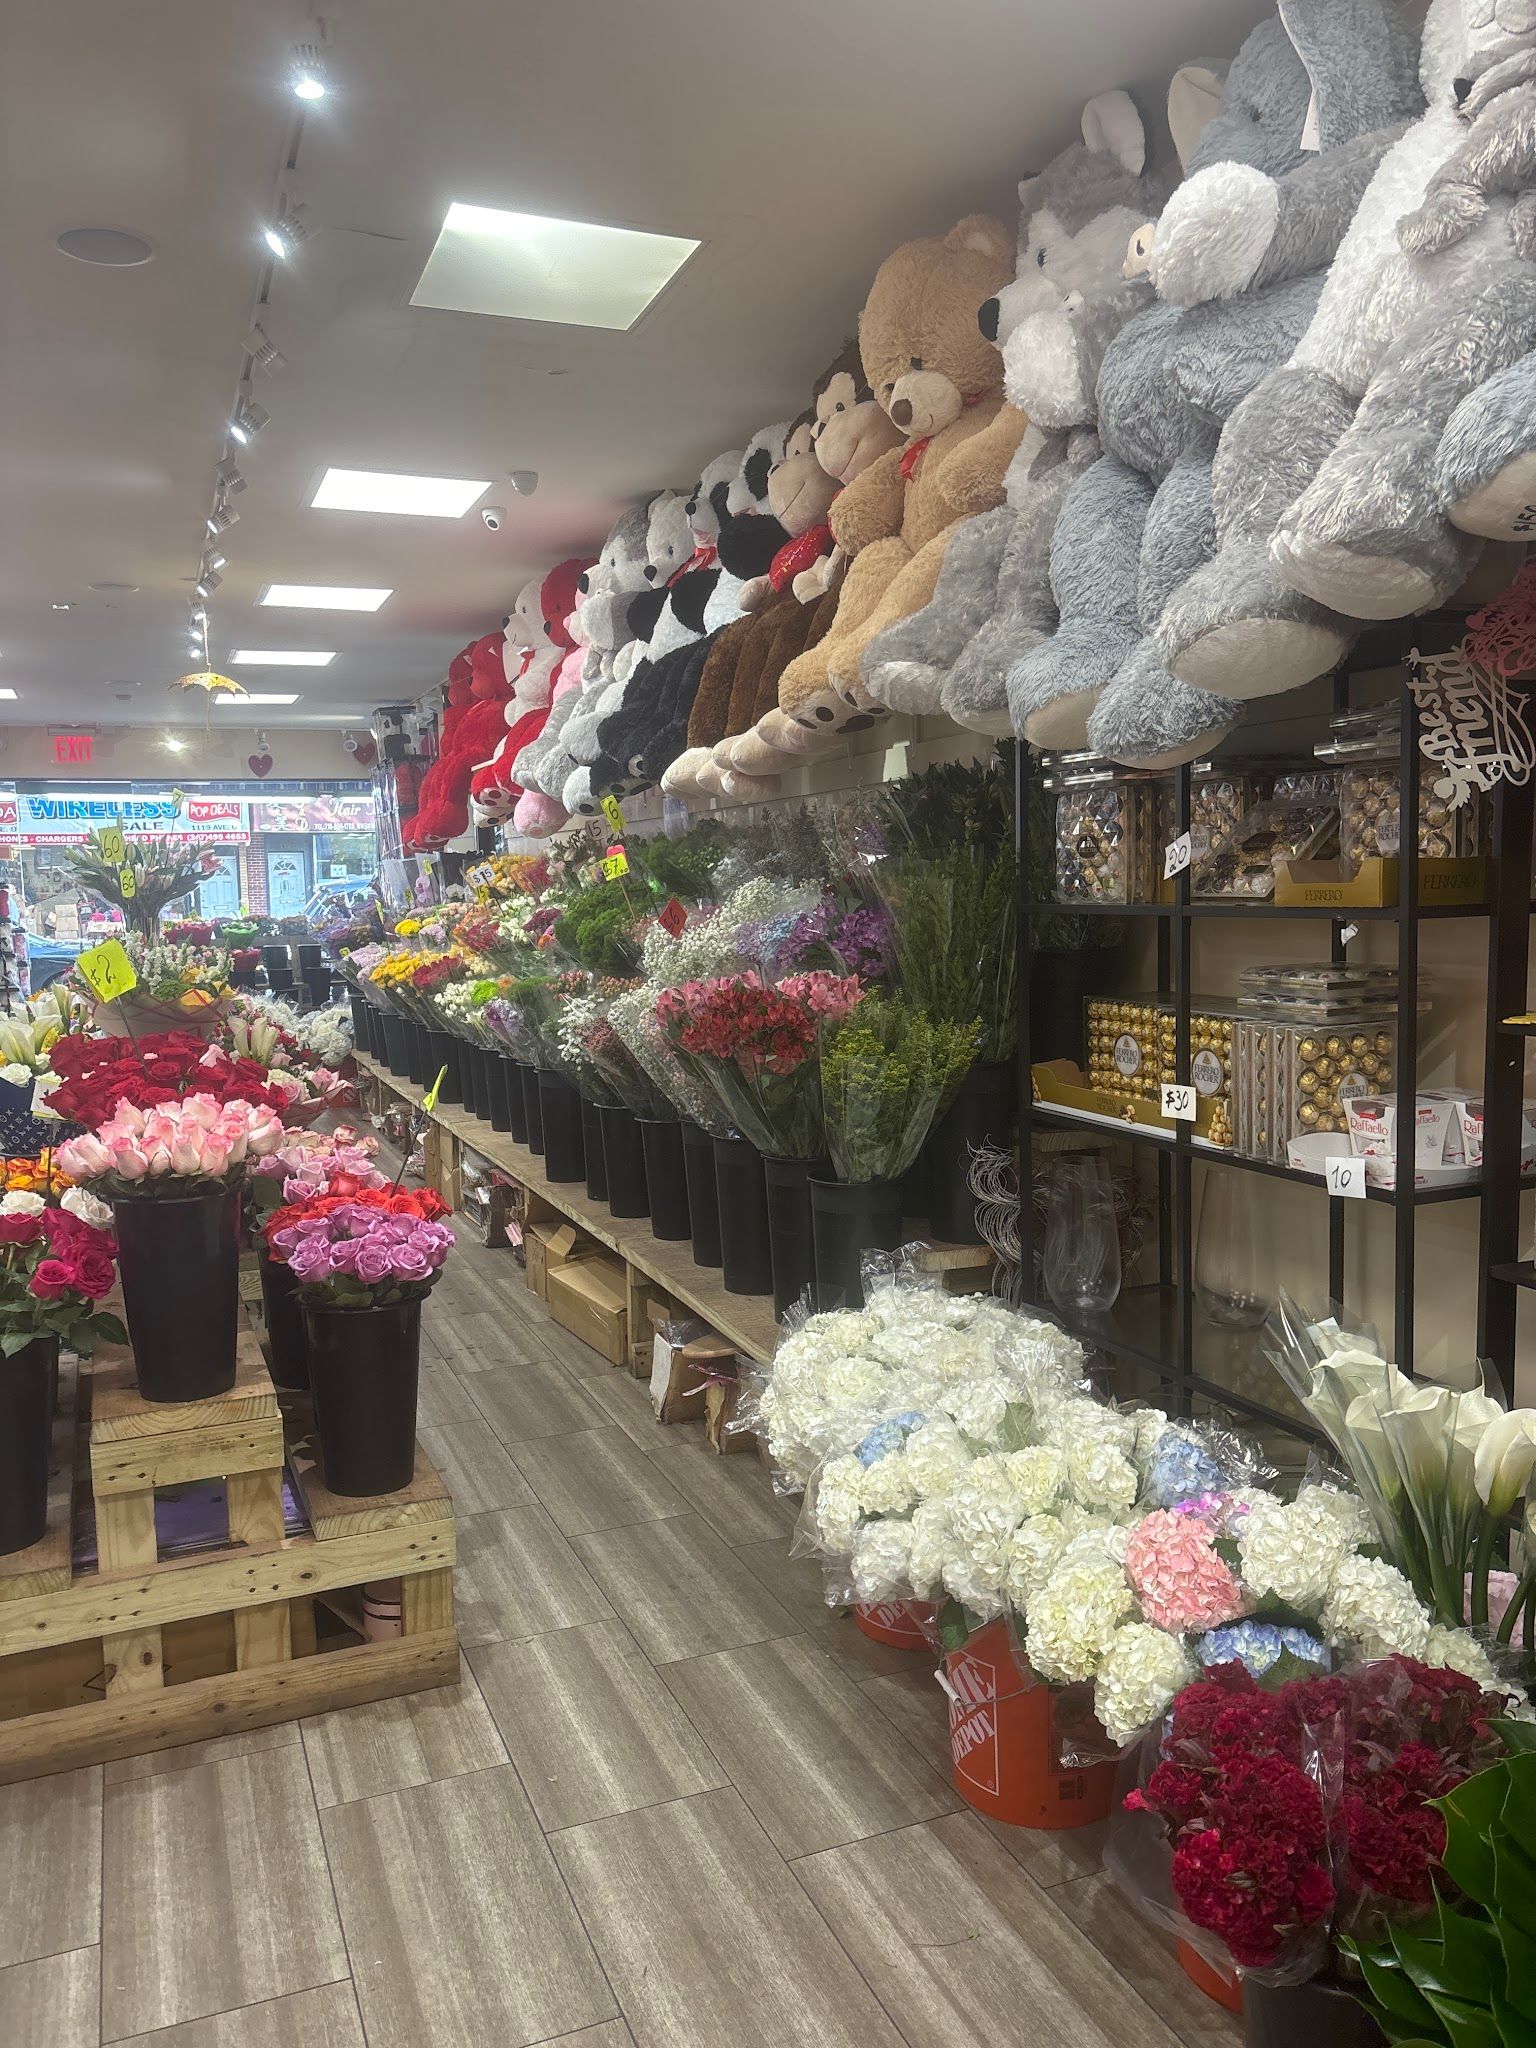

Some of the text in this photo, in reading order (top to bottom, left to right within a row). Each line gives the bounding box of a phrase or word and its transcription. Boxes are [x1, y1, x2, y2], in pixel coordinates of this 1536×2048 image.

[1406, 665, 1460, 760] Best
[55, 736, 94, 763] EXIT
[26, 797, 181, 819] WIRELESS
[190, 803, 239, 817] POP DEALS
[608, 800, 619, 820] 6
[35, 835, 84, 843] CHARGERS
[104, 834, 120, 858] 60
[1169, 845, 1188, 873] 20
[122, 875, 134, 891] 60
[1305, 889, 1342, 901] FERRERO
[1116, 1047, 1138, 1058] FERRERO
[1116, 1054, 1138, 1065] ROCHER
[1194, 1063, 1219, 1075] FERRERO
[1194, 1071, 1219, 1085] ROCHER
[1165, 1089, 1189, 1112] $30
[1350, 1117, 1389, 1136] Raffaello
[1332, 1165, 1352, 1189] 10
[952, 1711, 995, 1764] DEPOT
